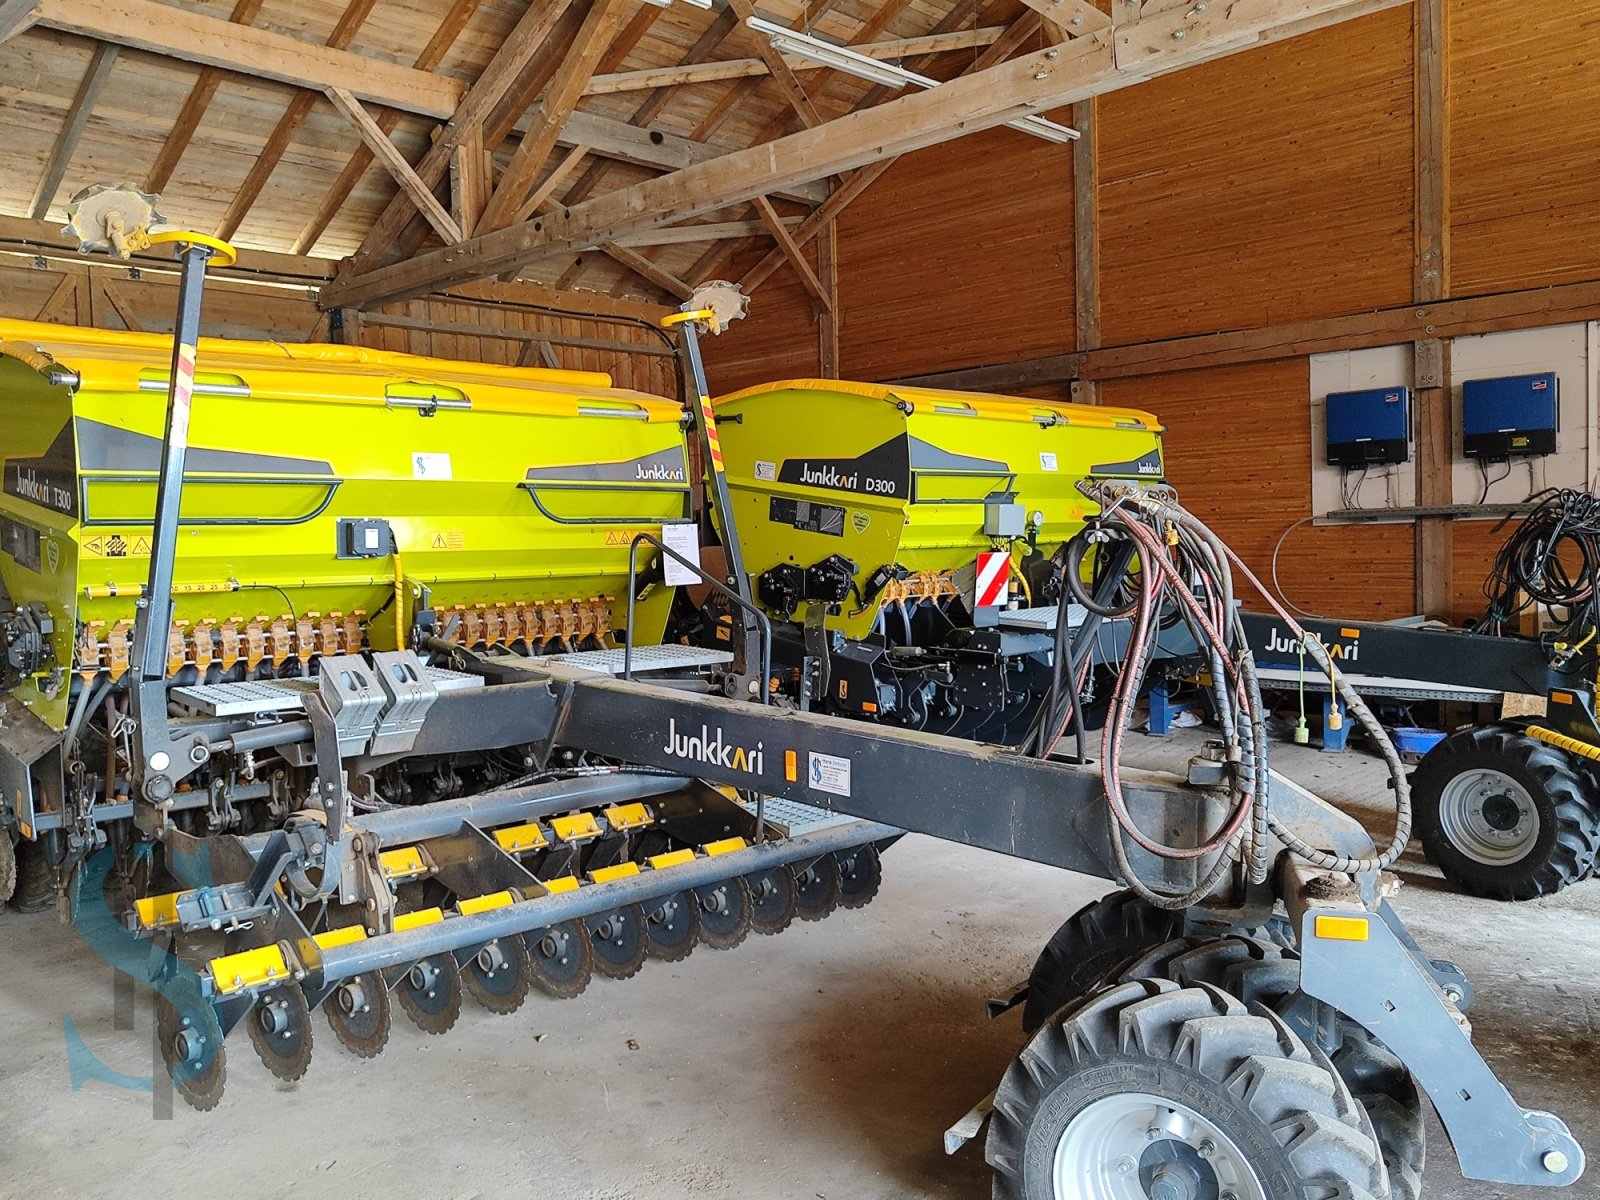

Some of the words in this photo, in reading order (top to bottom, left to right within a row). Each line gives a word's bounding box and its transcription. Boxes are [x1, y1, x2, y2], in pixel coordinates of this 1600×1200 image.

[636, 464, 683, 481] Junkkari
[800, 464, 858, 491] Junkkari
[866, 478, 896, 494] D300
[1138, 462, 1161, 474] Junkkari
[16, 465, 49, 503] Junkkari
[53, 487, 71, 510] T300
[1264, 628, 1359, 661] Junari
[663, 717, 764, 776] Junkkari
